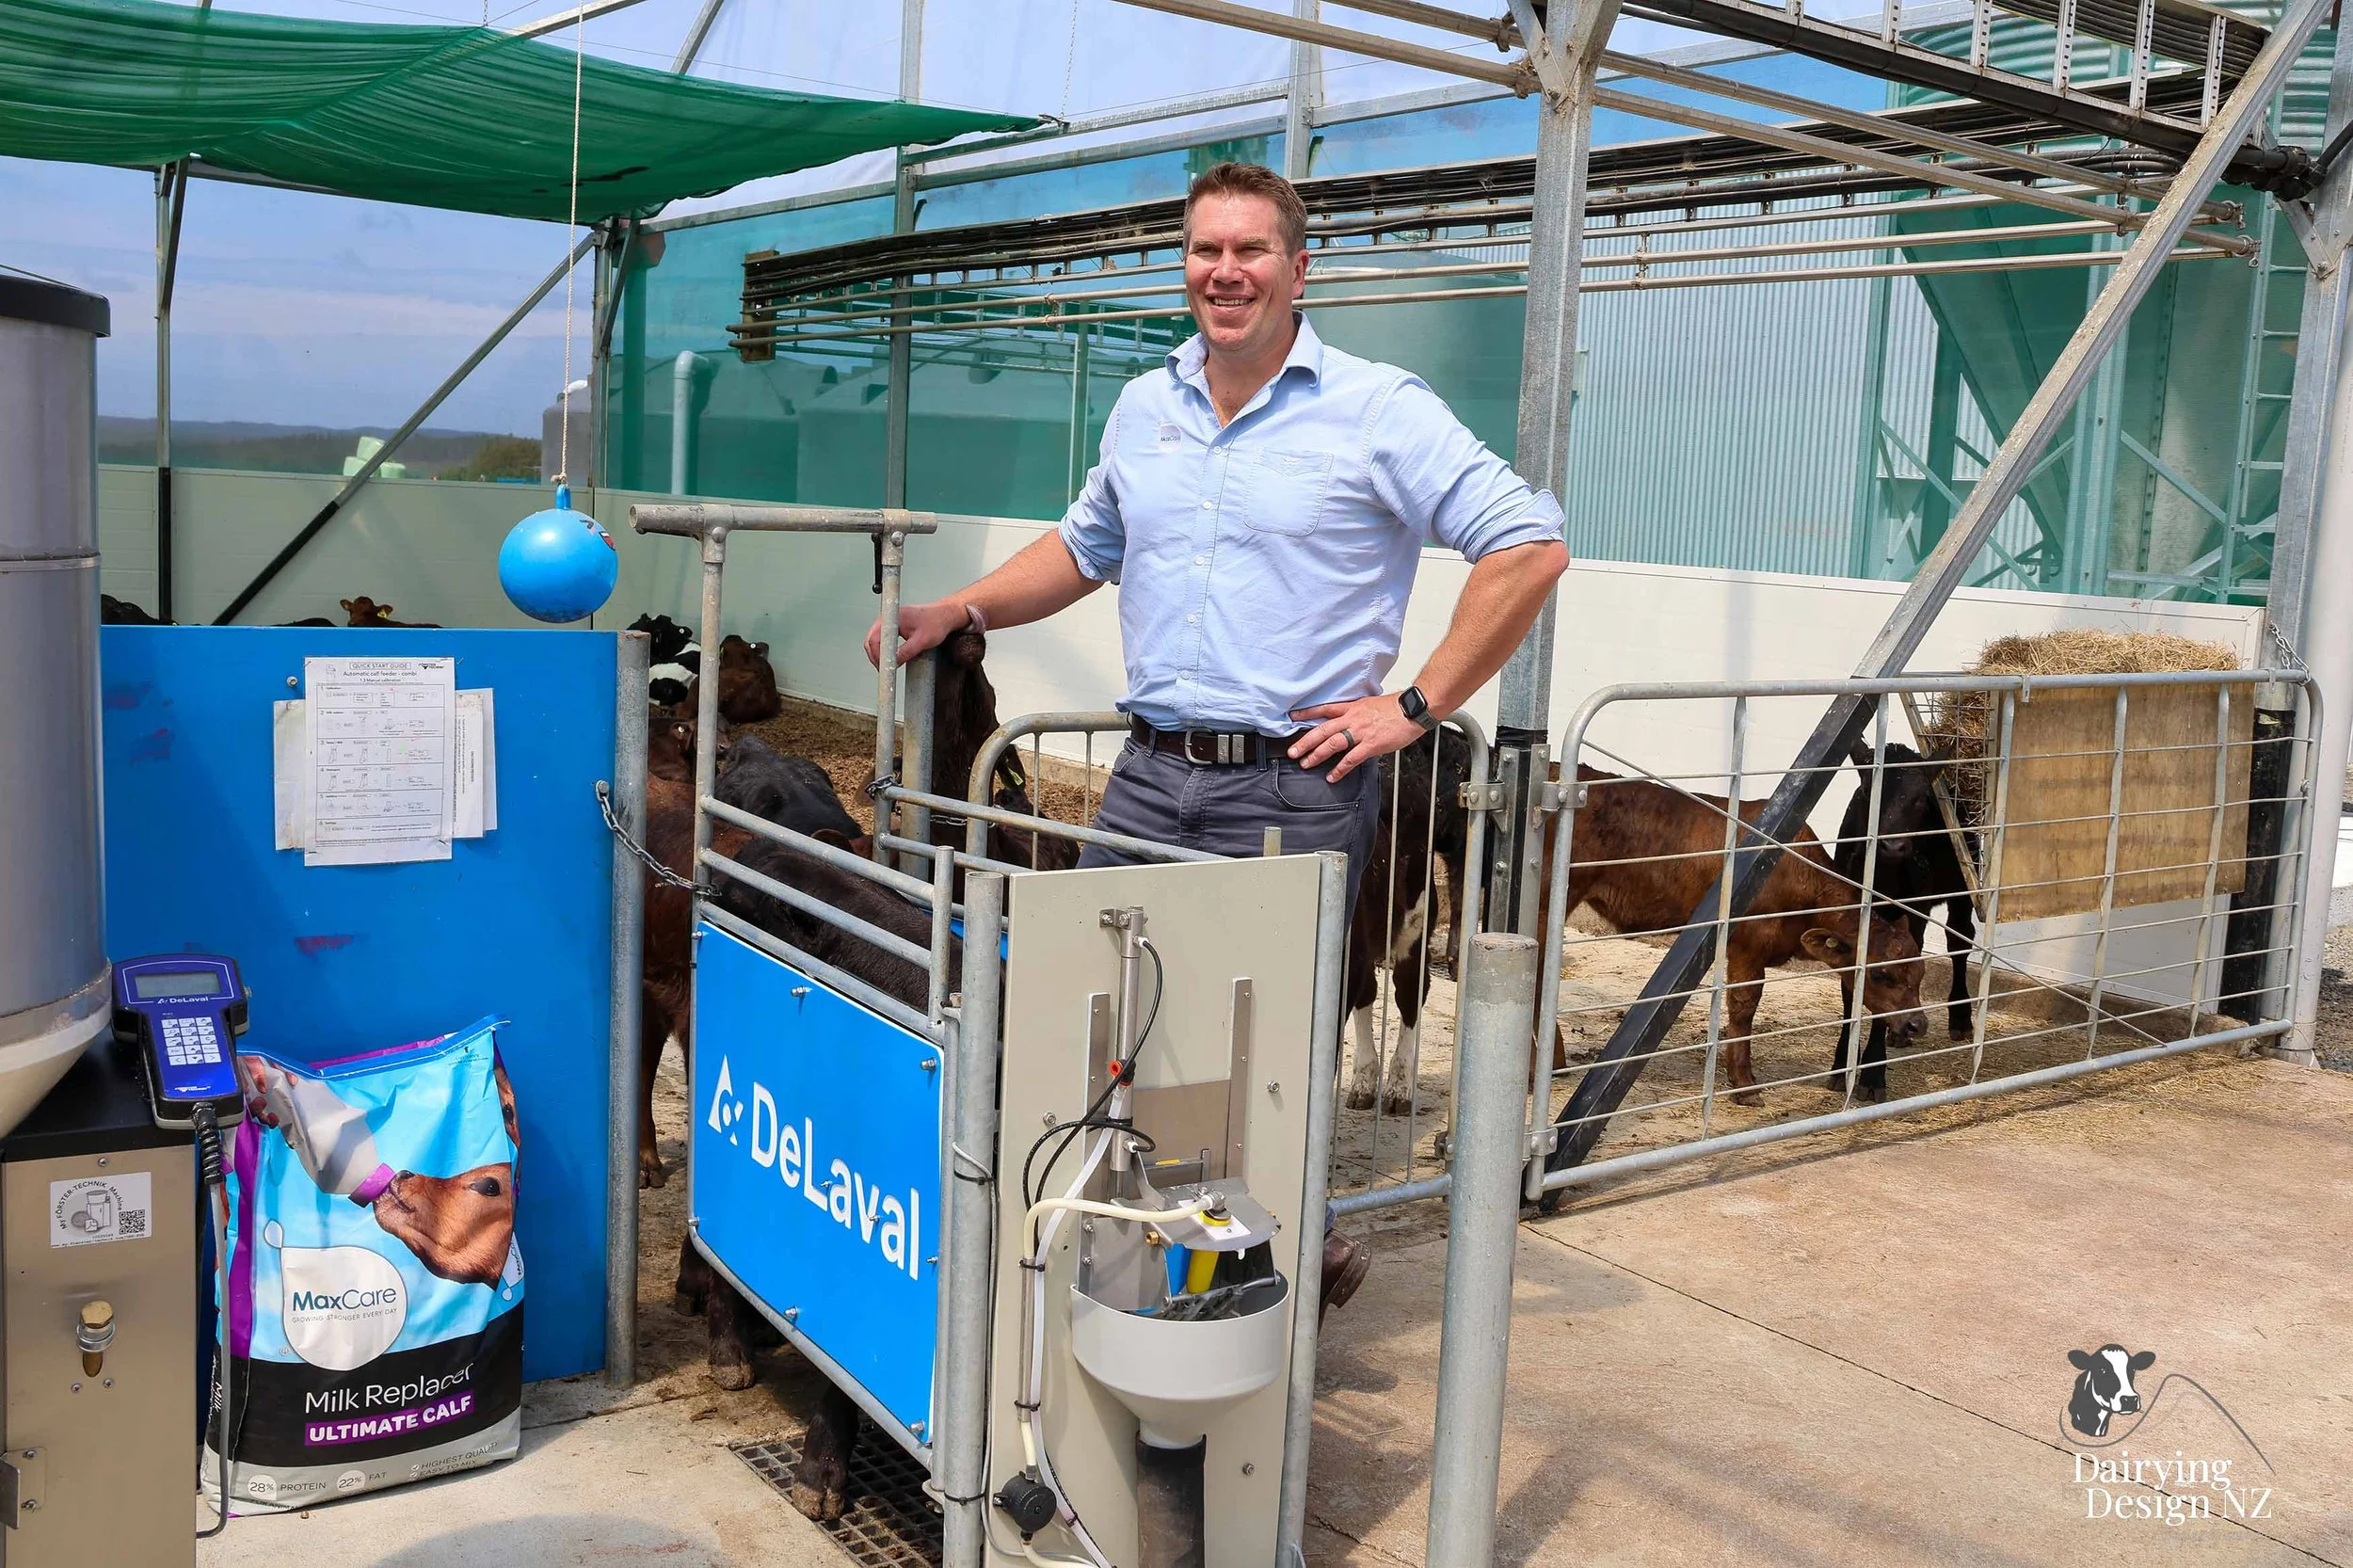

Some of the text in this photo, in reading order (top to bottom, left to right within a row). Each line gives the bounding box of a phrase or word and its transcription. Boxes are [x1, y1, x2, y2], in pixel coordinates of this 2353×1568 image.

[751, 1081, 920, 1281] DeLaval
[59, 1219, 68, 1230] MY
[109, 1186, 124, 1211] Machine
[293, 1288, 397, 1311] MaxCare
[292, 1315, 325, 1323] GROWING
[362, 1309, 383, 1319] EVERY
[305, 1362, 473, 1414] Milk Replacer
[309, 1395, 472, 1442] ULTIMATE CALF
[421, 1440, 499, 1469] HIGHEST QUALITY
[339, 1472, 388, 1489] 22% FAT
[420, 1467, 445, 1477] EASY
[249, 1481, 327, 1493] 28% PROTEIN
